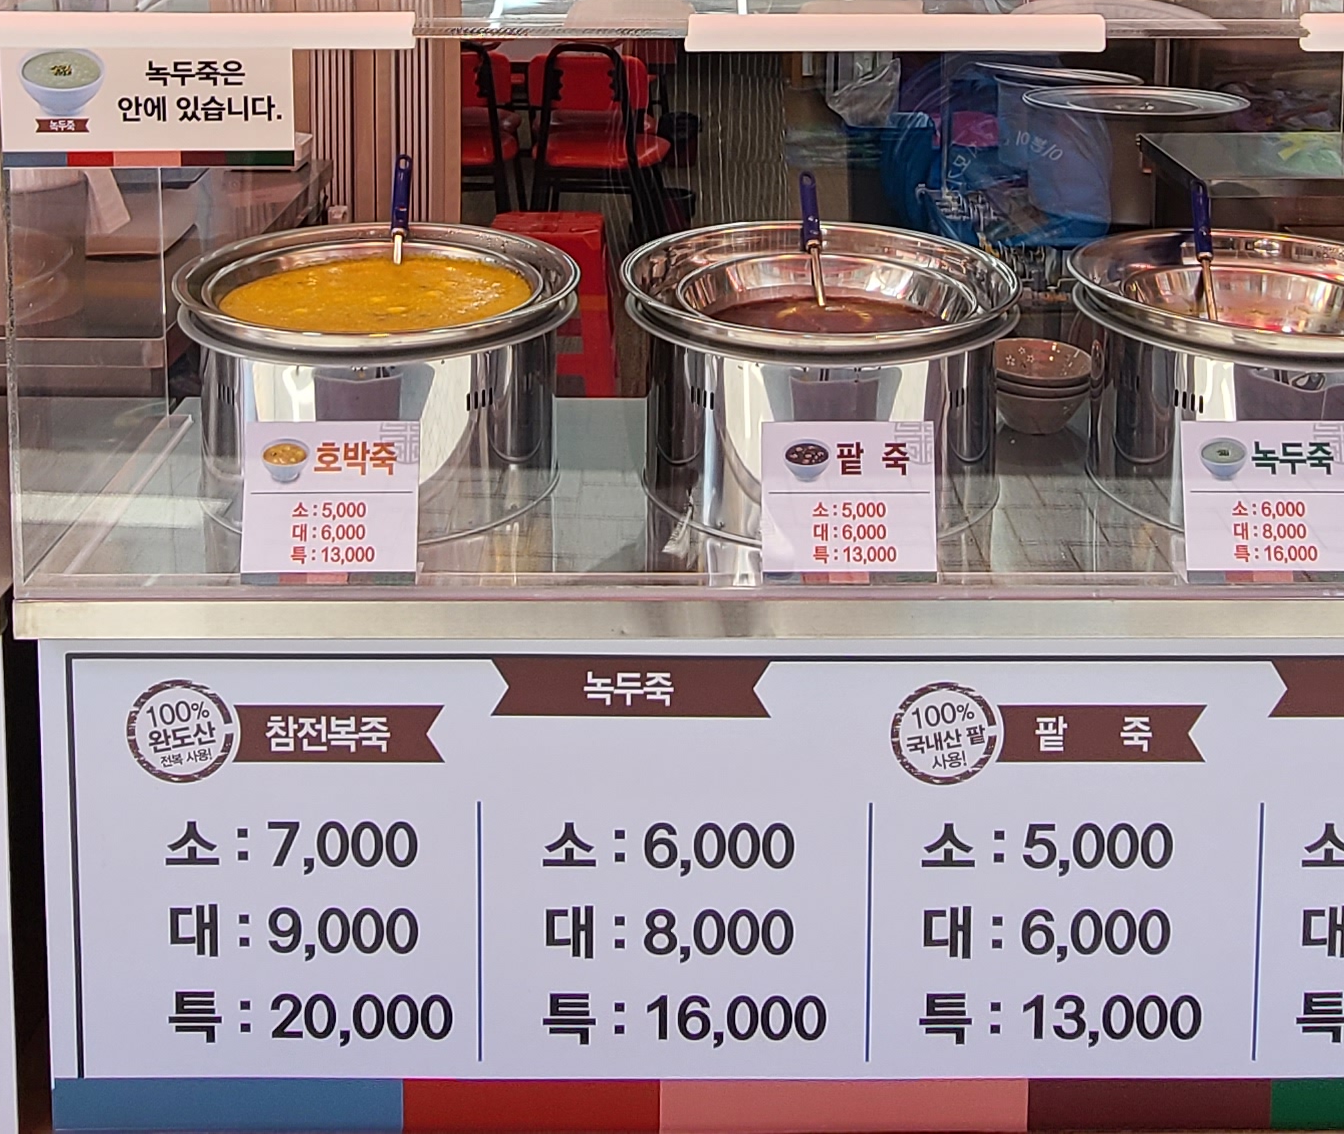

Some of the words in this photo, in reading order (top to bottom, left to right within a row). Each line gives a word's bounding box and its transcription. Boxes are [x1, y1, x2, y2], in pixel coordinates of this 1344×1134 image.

[145, 59, 246, 86] 녹두죽은
[117, 96, 167, 122] 안에
[176, 95, 284, 122] 있습니다.
[49, 118, 76, 133] 녹두죽
[314, 441, 397, 476] 호박죽
[1251, 441, 1334, 475] 녹두죽
[291, 502, 309, 518] 소
[322, 502, 366, 520] 5,000
[812, 502, 830, 518] 소
[842, 502, 886, 520] 5,000
[1232, 501, 1249, 517] 소
[1260, 501, 1306, 520] 6,000
[291, 523, 307, 542] 대
[321, 524, 366, 543] 6,000
[813, 523, 829, 542] 대
[842, 524, 887, 543] 6,000
[1233, 522, 1249, 541] 대
[1262, 523, 1307, 542] 8,000
[290, 546, 307, 565] 특
[321, 546, 375, 565] 13,000
[813, 546, 830, 564] 특
[843, 546, 897, 565] 13,000
[1234, 544, 1251, 563] 특
[1263, 545, 1318, 564] 16,000
[583, 671, 675, 707] 녹두죽
[146, 700, 210, 728] 100%
[911, 702, 975, 729] 100%
[148, 720, 216, 754] 완도산
[265, 715, 391, 753] 참전복죽
[906, 728, 962, 755] 국내산
[966, 724, 986, 746] 팥
[160, 752, 184, 768] 전복
[186, 747, 213, 764] 사용!
[932, 750, 967, 770] 사용!
[165, 820, 221, 868] 소
[266, 820, 419, 873] 7,000
[542, 821, 597, 869] 소
[642, 821, 796, 877] 6,000
[921, 822, 976, 869] 소
[1022, 821, 1174, 876] 5,000
[168, 903, 220, 958] 대
[267, 905, 419, 962] 9,000
[545, 905, 596, 960] 대
[642, 907, 795, 964] 8,000
[922, 904, 973, 960] 대
[1020, 907, 1172, 963] 6,000
[167, 990, 223, 1044] 특
[269, 992, 453, 1048] 20,000
[542, 992, 597, 1045] 특
[645, 993, 827, 1049] 16,000
[917, 991, 973, 1045] 특
[1021, 993, 1202, 1048] 13,000
